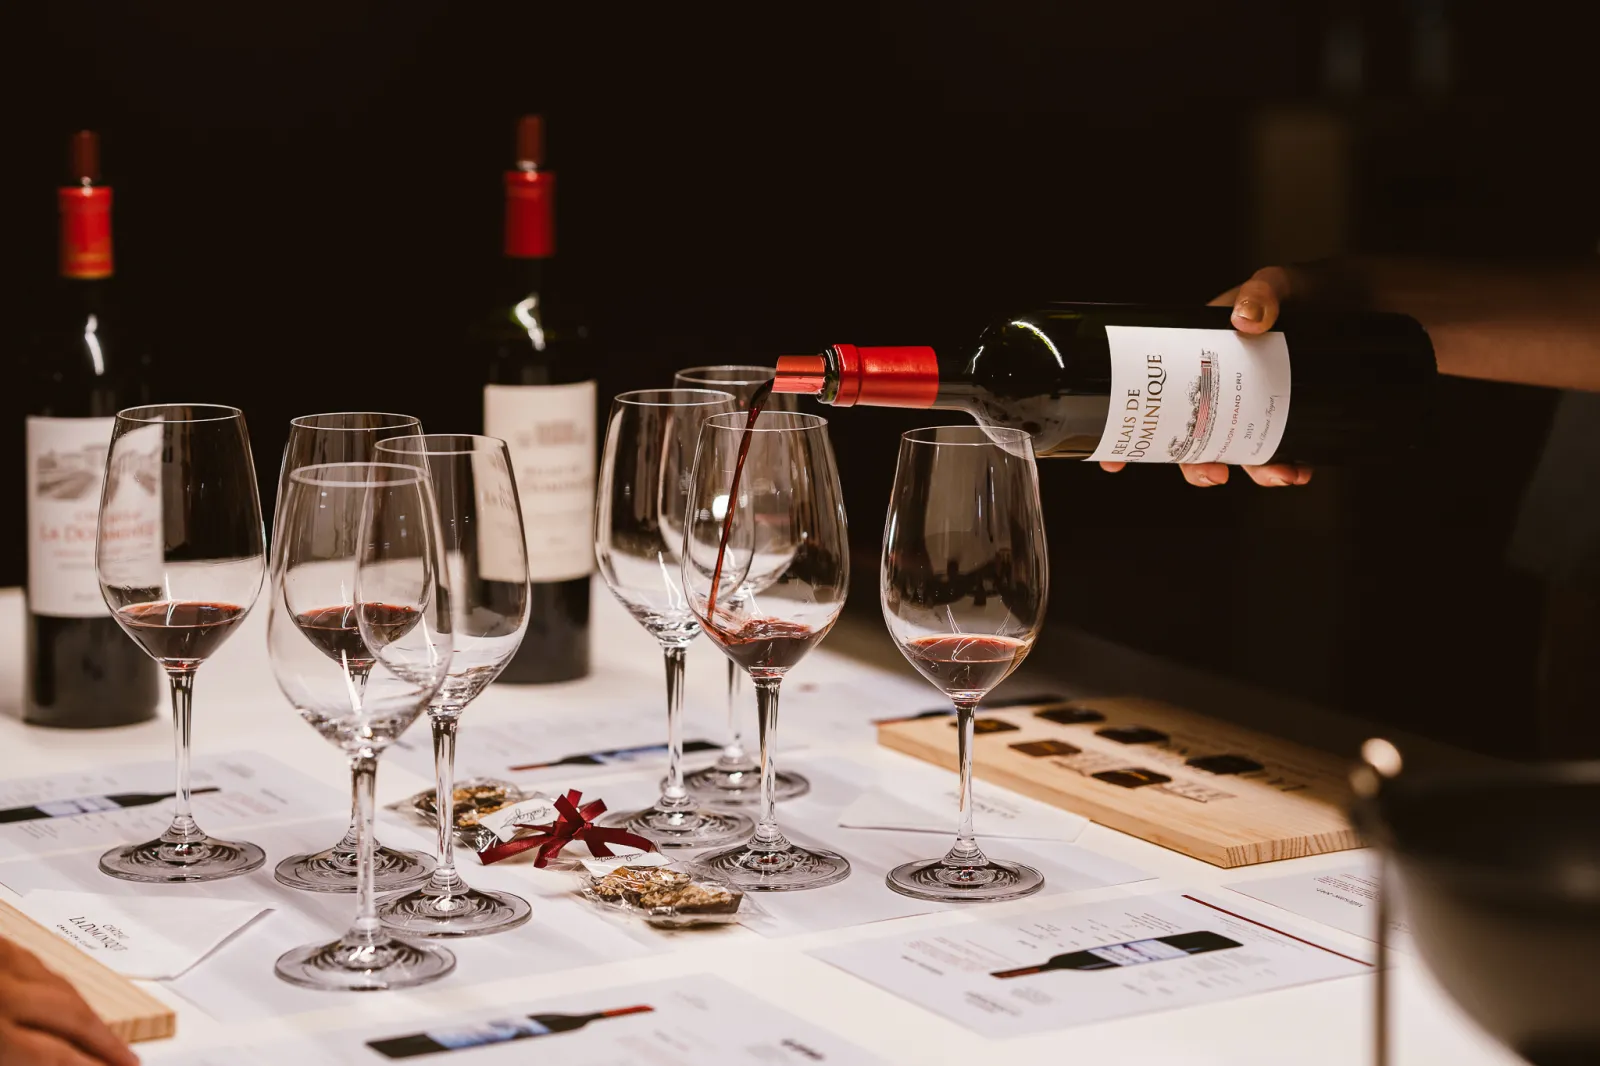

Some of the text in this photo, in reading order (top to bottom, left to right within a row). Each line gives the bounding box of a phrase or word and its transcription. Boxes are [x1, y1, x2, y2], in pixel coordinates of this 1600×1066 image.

[1111, 416, 1137, 455] RELAIS
[1126, 389, 1141, 411] DE
[1127, 354, 1167, 458] DOMINIQUE
[1231, 394, 1241, 425] GRAND
[1244, 422, 1255, 440] 2019
